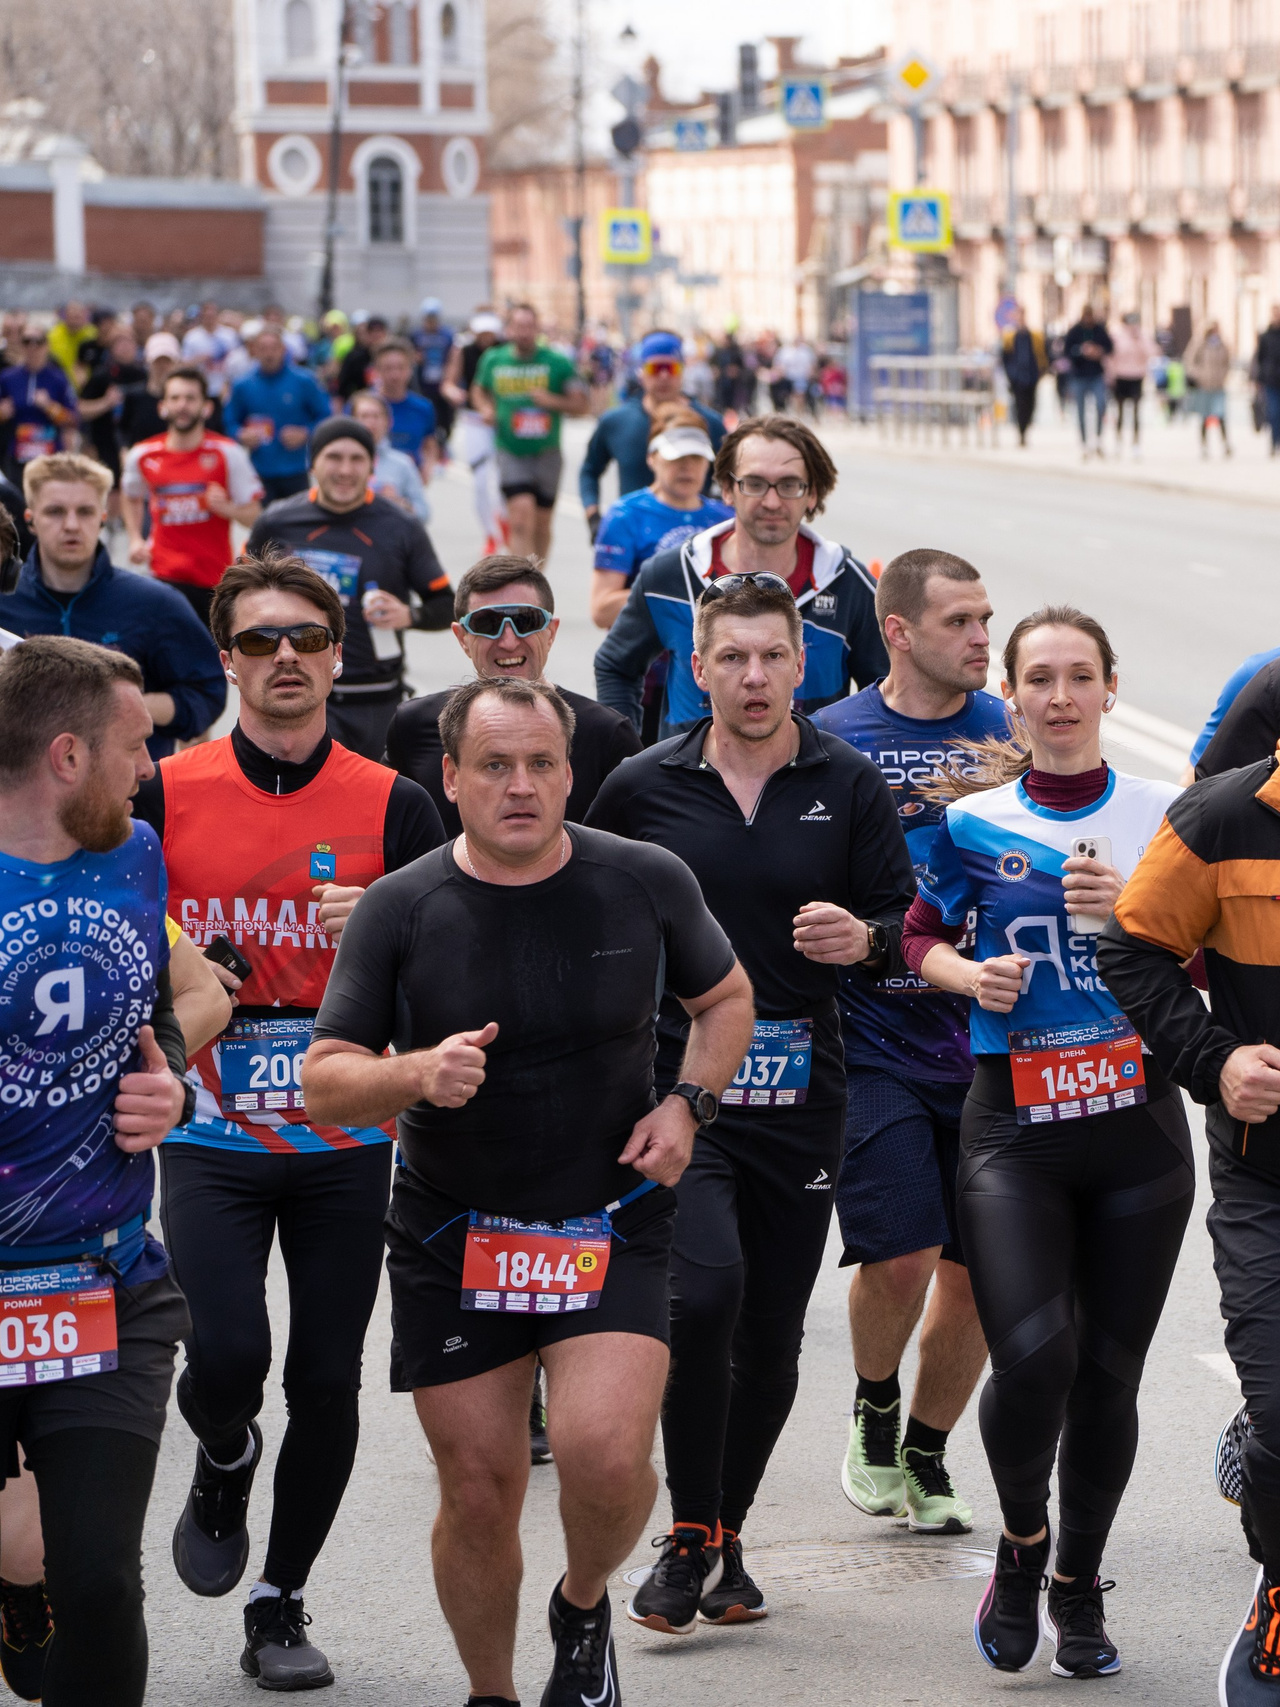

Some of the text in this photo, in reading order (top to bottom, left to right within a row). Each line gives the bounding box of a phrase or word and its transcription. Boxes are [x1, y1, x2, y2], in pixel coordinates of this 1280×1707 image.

[879, 751, 992, 765] ПРОСТ
[181, 897, 339, 949] SAMAR
[182, 920, 282, 932] INTERNATIONAL
[67, 897, 153, 981] КОСМОС
[601, 947, 633, 956] DEMIX
[1004, 916, 1071, 995] Я
[2, 943, 56, 992] ПРОСТО
[61, 941, 120, 981] КОСМОС
[34, 966, 85, 1037] Я
[69, 919, 142, 1078] Я ПРОСТО КОСМОС
[71, 1006, 123, 1059] ПРОСТО
[260, 1026, 314, 1034] КОСМОС
[1055, 1026, 1099, 1038] ПРОСТО
[272, 1040, 298, 1048] АРТУР
[1047, 1032, 1100, 1046] КОСМОС
[7, 1034, 66, 1064] КОСМОС
[1059, 1049, 1086, 1059] ЕЛЕНА
[732, 1055, 788, 1086] 037
[1124, 1063, 1134, 1074] D
[39, 1070, 54, 1086] Я
[1041, 1058, 1118, 1100] 1454
[582, 1256, 593, 1267] B
[4, 1272, 60, 1284] ПРОСТО
[495, 1251, 578, 1290] 1844
[4, 1298, 42, 1310] РОМАН
[0, 1311, 78, 1359] 036
